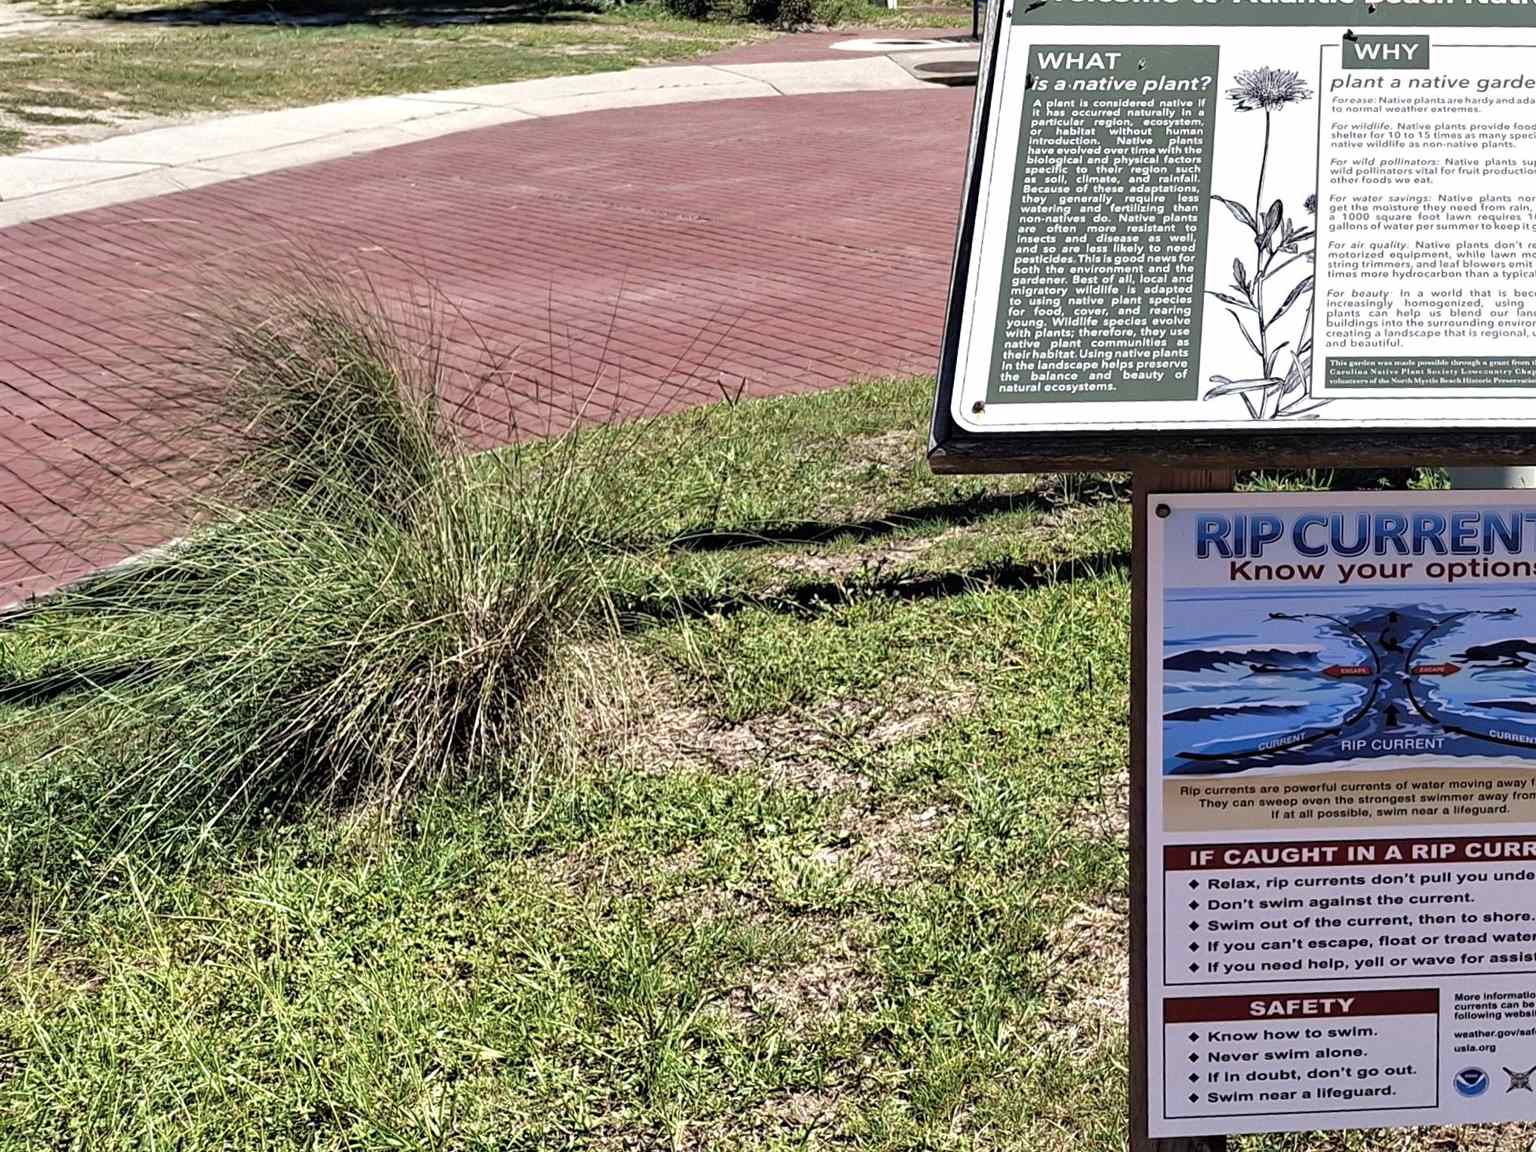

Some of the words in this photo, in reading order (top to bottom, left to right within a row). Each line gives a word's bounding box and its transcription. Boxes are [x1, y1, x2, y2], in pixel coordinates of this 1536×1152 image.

[1037, 53, 1121, 69] WHAT
[1354, 44, 1419, 60] WHY
[1032, 76, 1048, 90] is
[1054, 79, 1066, 90] a
[1072, 76, 1137, 90] native
[1142, 76, 1212, 95] plant?
[1330, 74, 1385, 91] plant
[1390, 78, 1401, 88] a
[1408, 76, 1470, 88] native
[1033, 99, 1042, 107] A
[1047, 99, 1075, 109] plant
[1080, 99, 1088, 107] is
[1093, 99, 1154, 107] considered
[1160, 99, 1193, 107] native
[1198, 99, 1205, 107] if
[1330, 158, 1347, 166] For
[1352, 158, 1375, 166] wild
[1380, 158, 1440, 168] pollinators:
[1445, 158, 1479, 166] Native
[1485, 158, 1517, 168] plants
[1006, 319, 1047, 329] young.
[1052, 317, 1098, 326] Wildlife
[1103, 318, 1147, 328] species
[1152, 317, 1191, 326] evolve
[1195, 512, 1284, 559] RIP
[1229, 559, 1324, 581] Know
[1338, 560, 1413, 583] your
[1258, 732, 1306, 750] CURRENT
[1341, 740, 1366, 751] RIP
[1372, 738, 1444, 750] CURRENT
[1180, 786, 1200, 797] Rip
[1205, 785, 1256, 795] currents
[1260, 785, 1279, 793] are
[1284, 783, 1337, 794] powerful
[1341, 782, 1391, 792] currents
[1396, 781, 1407, 790] of
[1412, 781, 1445, 790] water
[1449, 780, 1493, 790] moving
[1497, 779, 1527, 789] away
[1190, 851, 1214, 866] IF
[1224, 847, 1338, 864] CAUGHT
[1348, 846, 1375, 861] IN
[1384, 846, 1402, 860] A
[1412, 844, 1456, 859] RIP
[1208, 879, 1260, 891] Relax,
[1266, 878, 1288, 889] rip
[1294, 876, 1365, 887] currents
[1372, 874, 1414, 885] don't
[1420, 872, 1451, 885] pull
[1456, 873, 1488, 885] you
[1208, 899, 1254, 911] Don't
[1259, 898, 1303, 909] swim
[1309, 896, 1372, 909] against
[1377, 895, 1403, 905] the
[1409, 893, 1475, 904] current.
[1208, 920, 1254, 931] Swim
[1260, 919, 1287, 930] out
[1293, 918, 1310, 928] of
[1315, 917, 1342, 928] the
[1347, 915, 1413, 926] current,
[1419, 913, 1455, 924] then
[1462, 913, 1478, 923] to
[1483, 911, 1535, 923] shore.
[1208, 941, 1218, 952] If
[1224, 942, 1255, 954] you
[1261, 939, 1303, 950] can't
[1308, 938, 1372, 950] escape,
[1379, 935, 1416, 946] float
[1421, 935, 1439, 945] or
[1445, 933, 1487, 944] tread
[1208, 962, 1218, 973] If
[1224, 963, 1255, 974] you
[1261, 960, 1302, 971] need
[1308, 958, 1349, 970] help,
[1355, 956, 1383, 969] yell
[1390, 956, 1407, 967] or
[1413, 955, 1456, 965] wave
[1461, 954, 1484, 964] for
[1454, 993, 1480, 1001] More
[1250, 998, 1355, 1016] SAFETY
[1208, 1031, 1257, 1042] Know
[1264, 1030, 1299, 1040] how
[1305, 1028, 1322, 1039] to
[1327, 1027, 1378, 1038] swim.
[1208, 1051, 1259, 1062] Never
[1264, 1049, 1309, 1060] swim
[1315, 1047, 1367, 1059] alone.
[1208, 1092, 1253, 1103] Swim
[1259, 1090, 1296, 1101] near
[1302, 1091, 1311, 1099] a
[1316, 1086, 1396, 1099] lifeguard.
